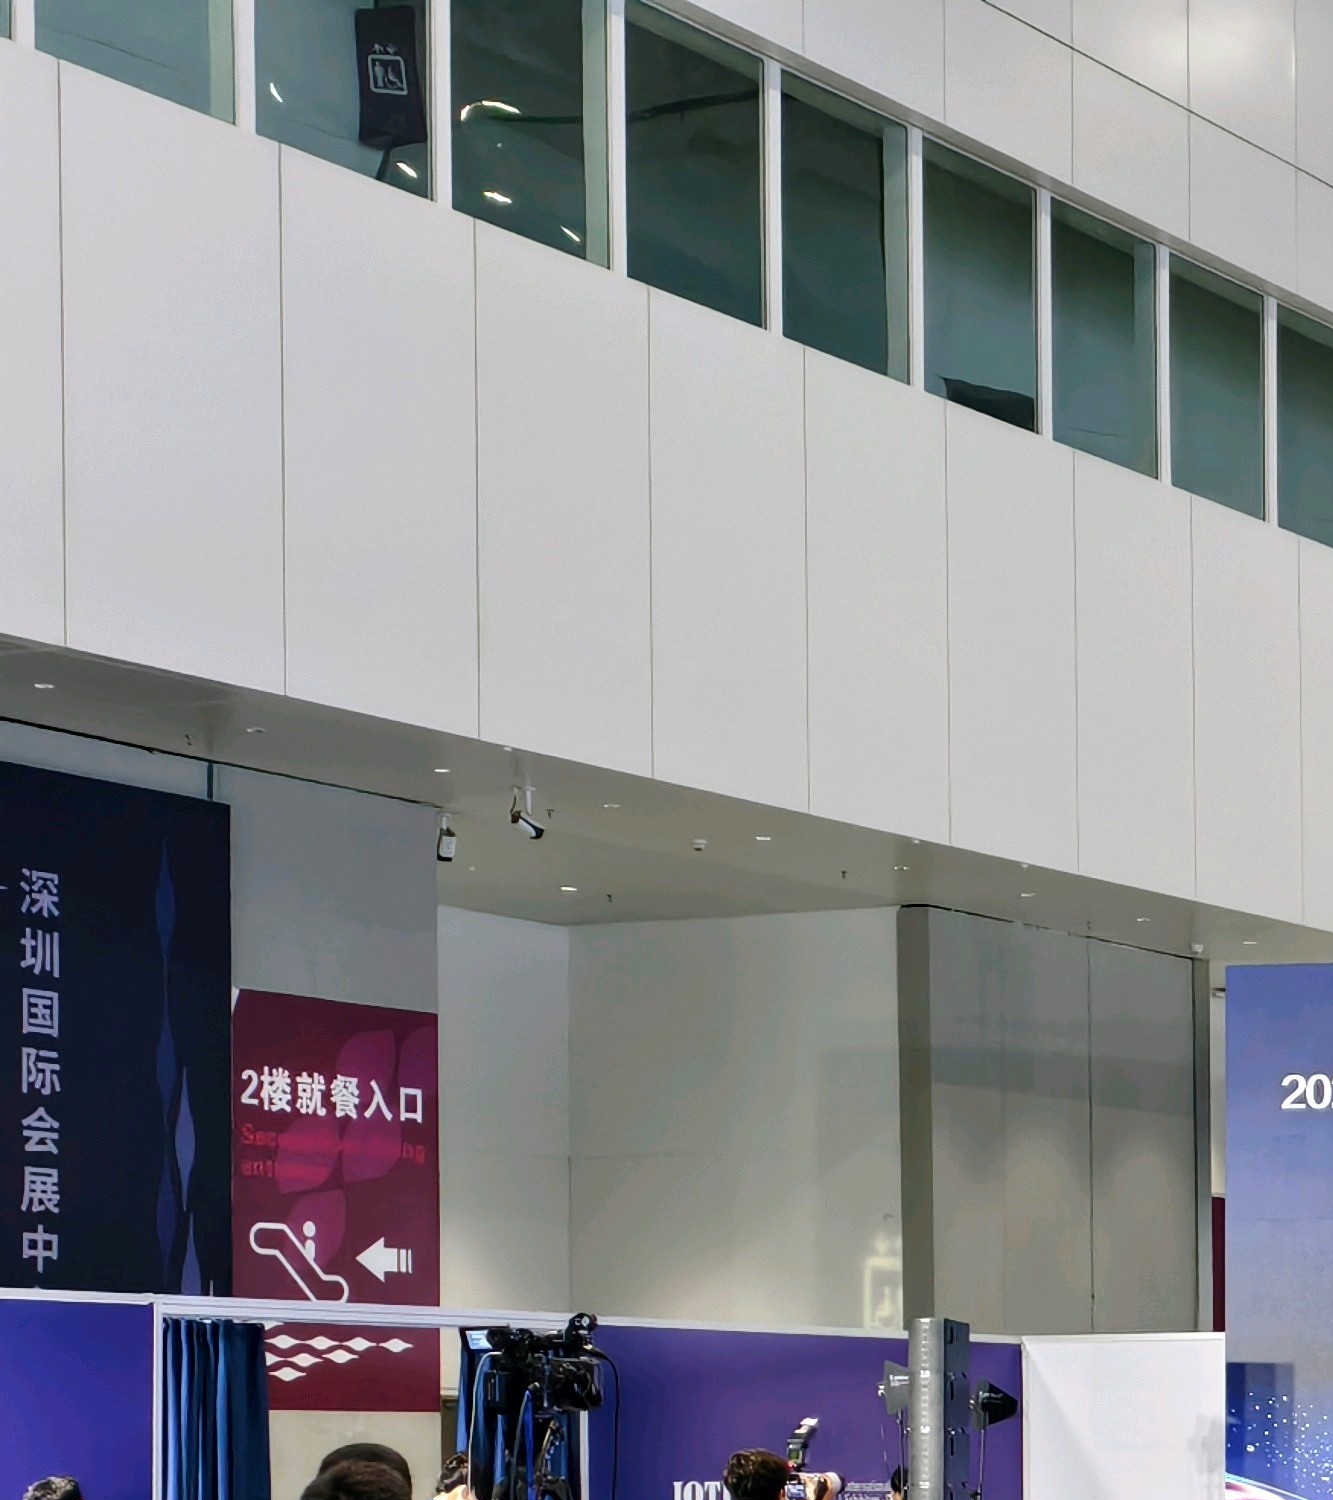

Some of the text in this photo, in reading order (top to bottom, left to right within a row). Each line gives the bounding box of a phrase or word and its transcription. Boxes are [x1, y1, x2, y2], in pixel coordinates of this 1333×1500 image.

[20, 868, 61, 1274] 深圳国际会展中
[240, 1065, 424, 1125] 2楼就餐入口
